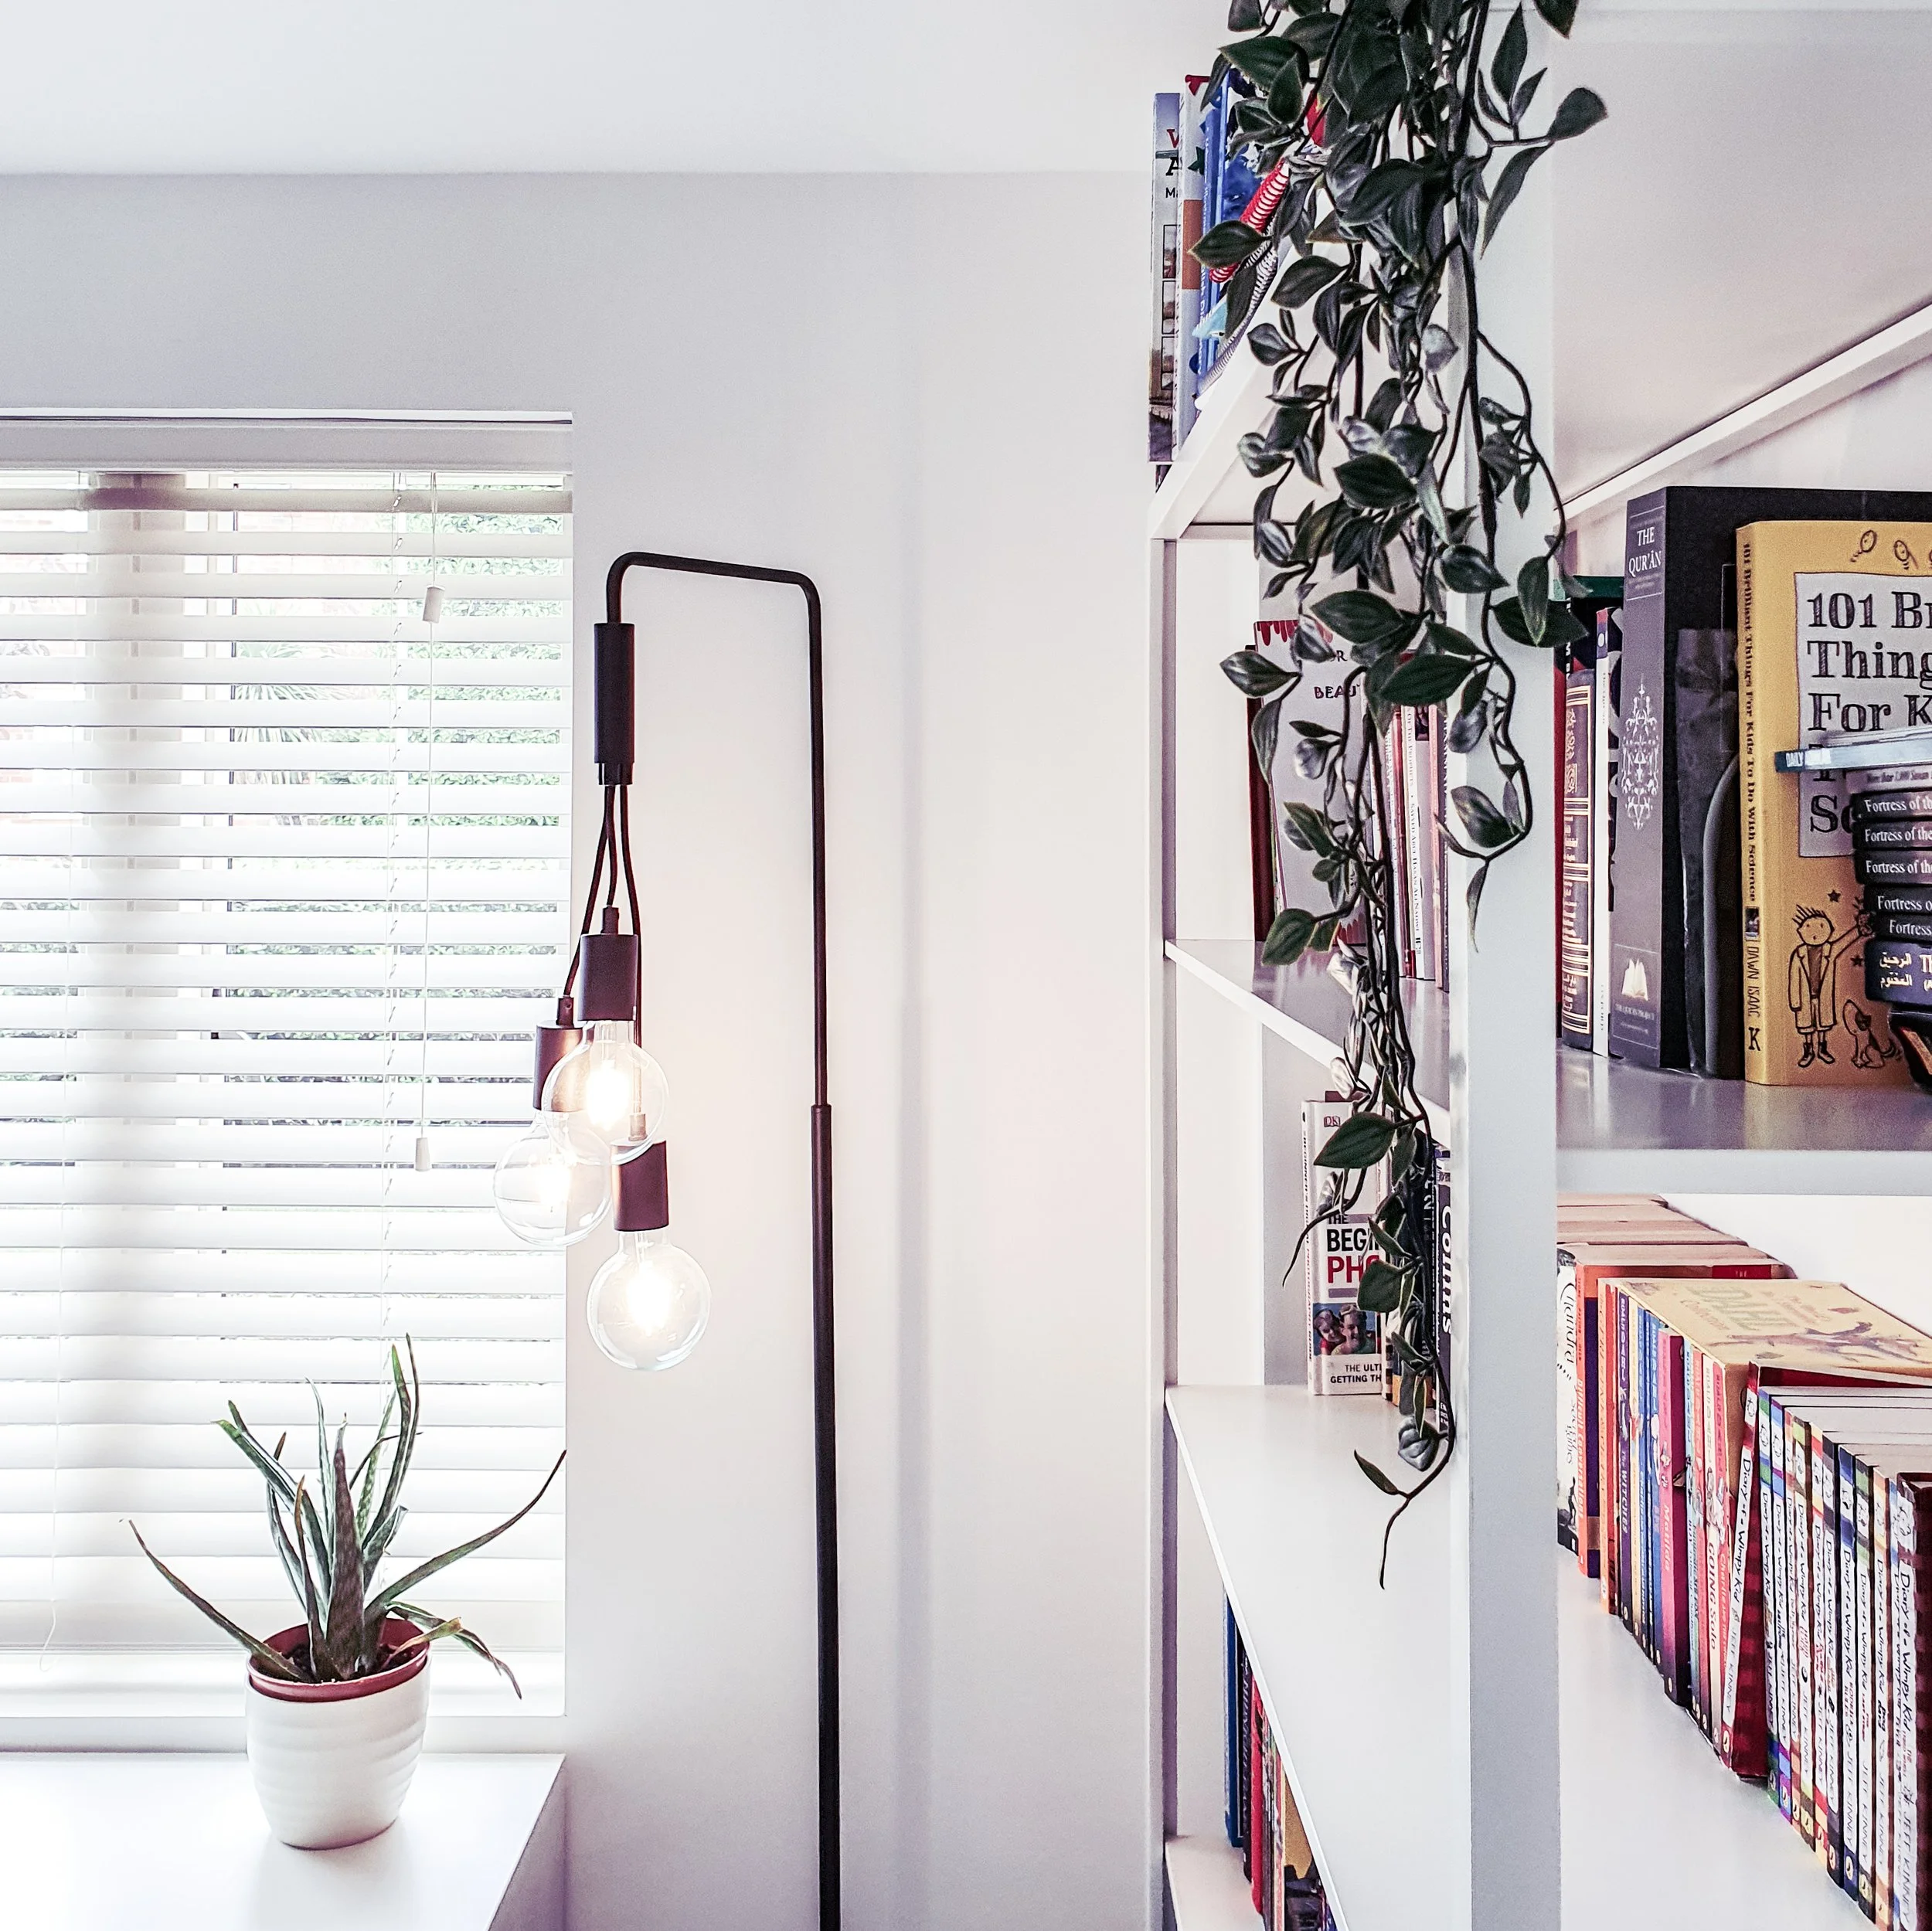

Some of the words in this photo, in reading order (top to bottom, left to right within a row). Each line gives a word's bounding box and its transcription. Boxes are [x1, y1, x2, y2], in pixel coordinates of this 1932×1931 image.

[1637, 526, 1655, 546] THE
[1807, 592, 1877, 629] 101
[1314, 684, 1362, 699] BEAU
[1808, 692, 1892, 733] For
[1904, 695, 1932, 726] K
[1747, 757, 1754, 777] To
[1863, 799, 1907, 813] Fortress
[1909, 795, 1921, 810] of
[1922, 795, 1932, 810] th
[1865, 828, 1903, 842] Fortress
[1904, 827, 1917, 841] of
[1866, 860, 1906, 874] Fortress
[1907, 859, 1920, 874] of
[1877, 896, 1923, 911] Fortress
[1925, 900, 1932, 911] o
[1889, 920, 1932, 936] Fortress
[1747, 946, 1760, 980] DAWN
[1748, 985, 1760, 1019] ISAAC
[1323, 1115, 1341, 1127] DK
[1327, 1228, 1379, 1252] BEGI
[1330, 1375, 1368, 1384] GETTING
[1370, 1374, 1382, 1382] TH
[1345, 1364, 1361, 1372] THE
[1363, 1363, 1382, 1372] ULTI
[1740, 1458, 1752, 1501] Diary
[1734, 1529, 1746, 1576] Wimpy
[1733, 1579, 1742, 1603] Kid
[1901, 1572, 1910, 1620] Diary
[1842, 1613, 1852, 1654] Wimpy
[1725, 1663, 1736, 1714] KINNEY
[1903, 1651, 1911, 1702] Wimpy
[1903, 1703, 1913, 1732] Kid
[1903, 1858, 1911, 1923] KINNEY
